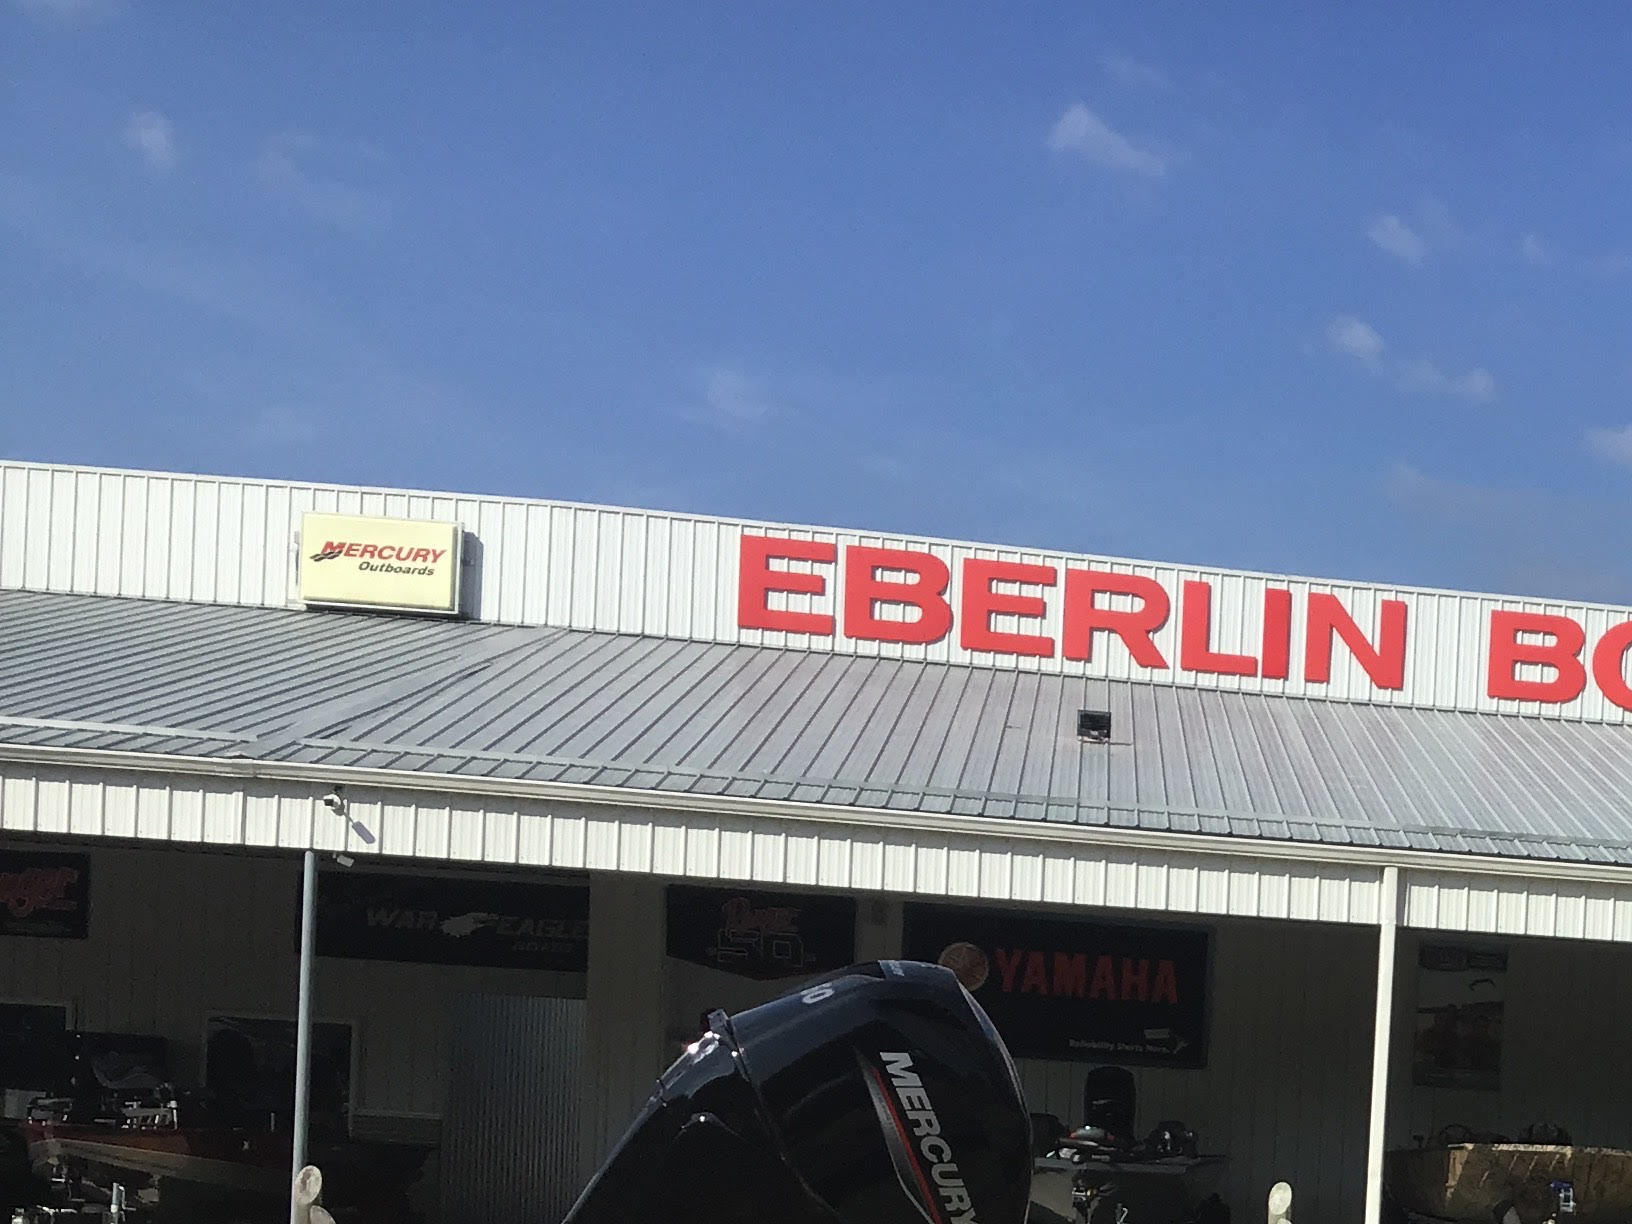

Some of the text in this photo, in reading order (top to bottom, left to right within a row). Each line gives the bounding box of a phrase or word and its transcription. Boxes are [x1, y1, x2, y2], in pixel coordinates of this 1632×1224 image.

[320, 541, 448, 564] MERCURY
[358, 561, 435, 576] Outboards
[738, 534, 1408, 691] EBERLIN
[366, 908, 438, 930] WAR
[993, 947, 1180, 1005] YAMAHA
